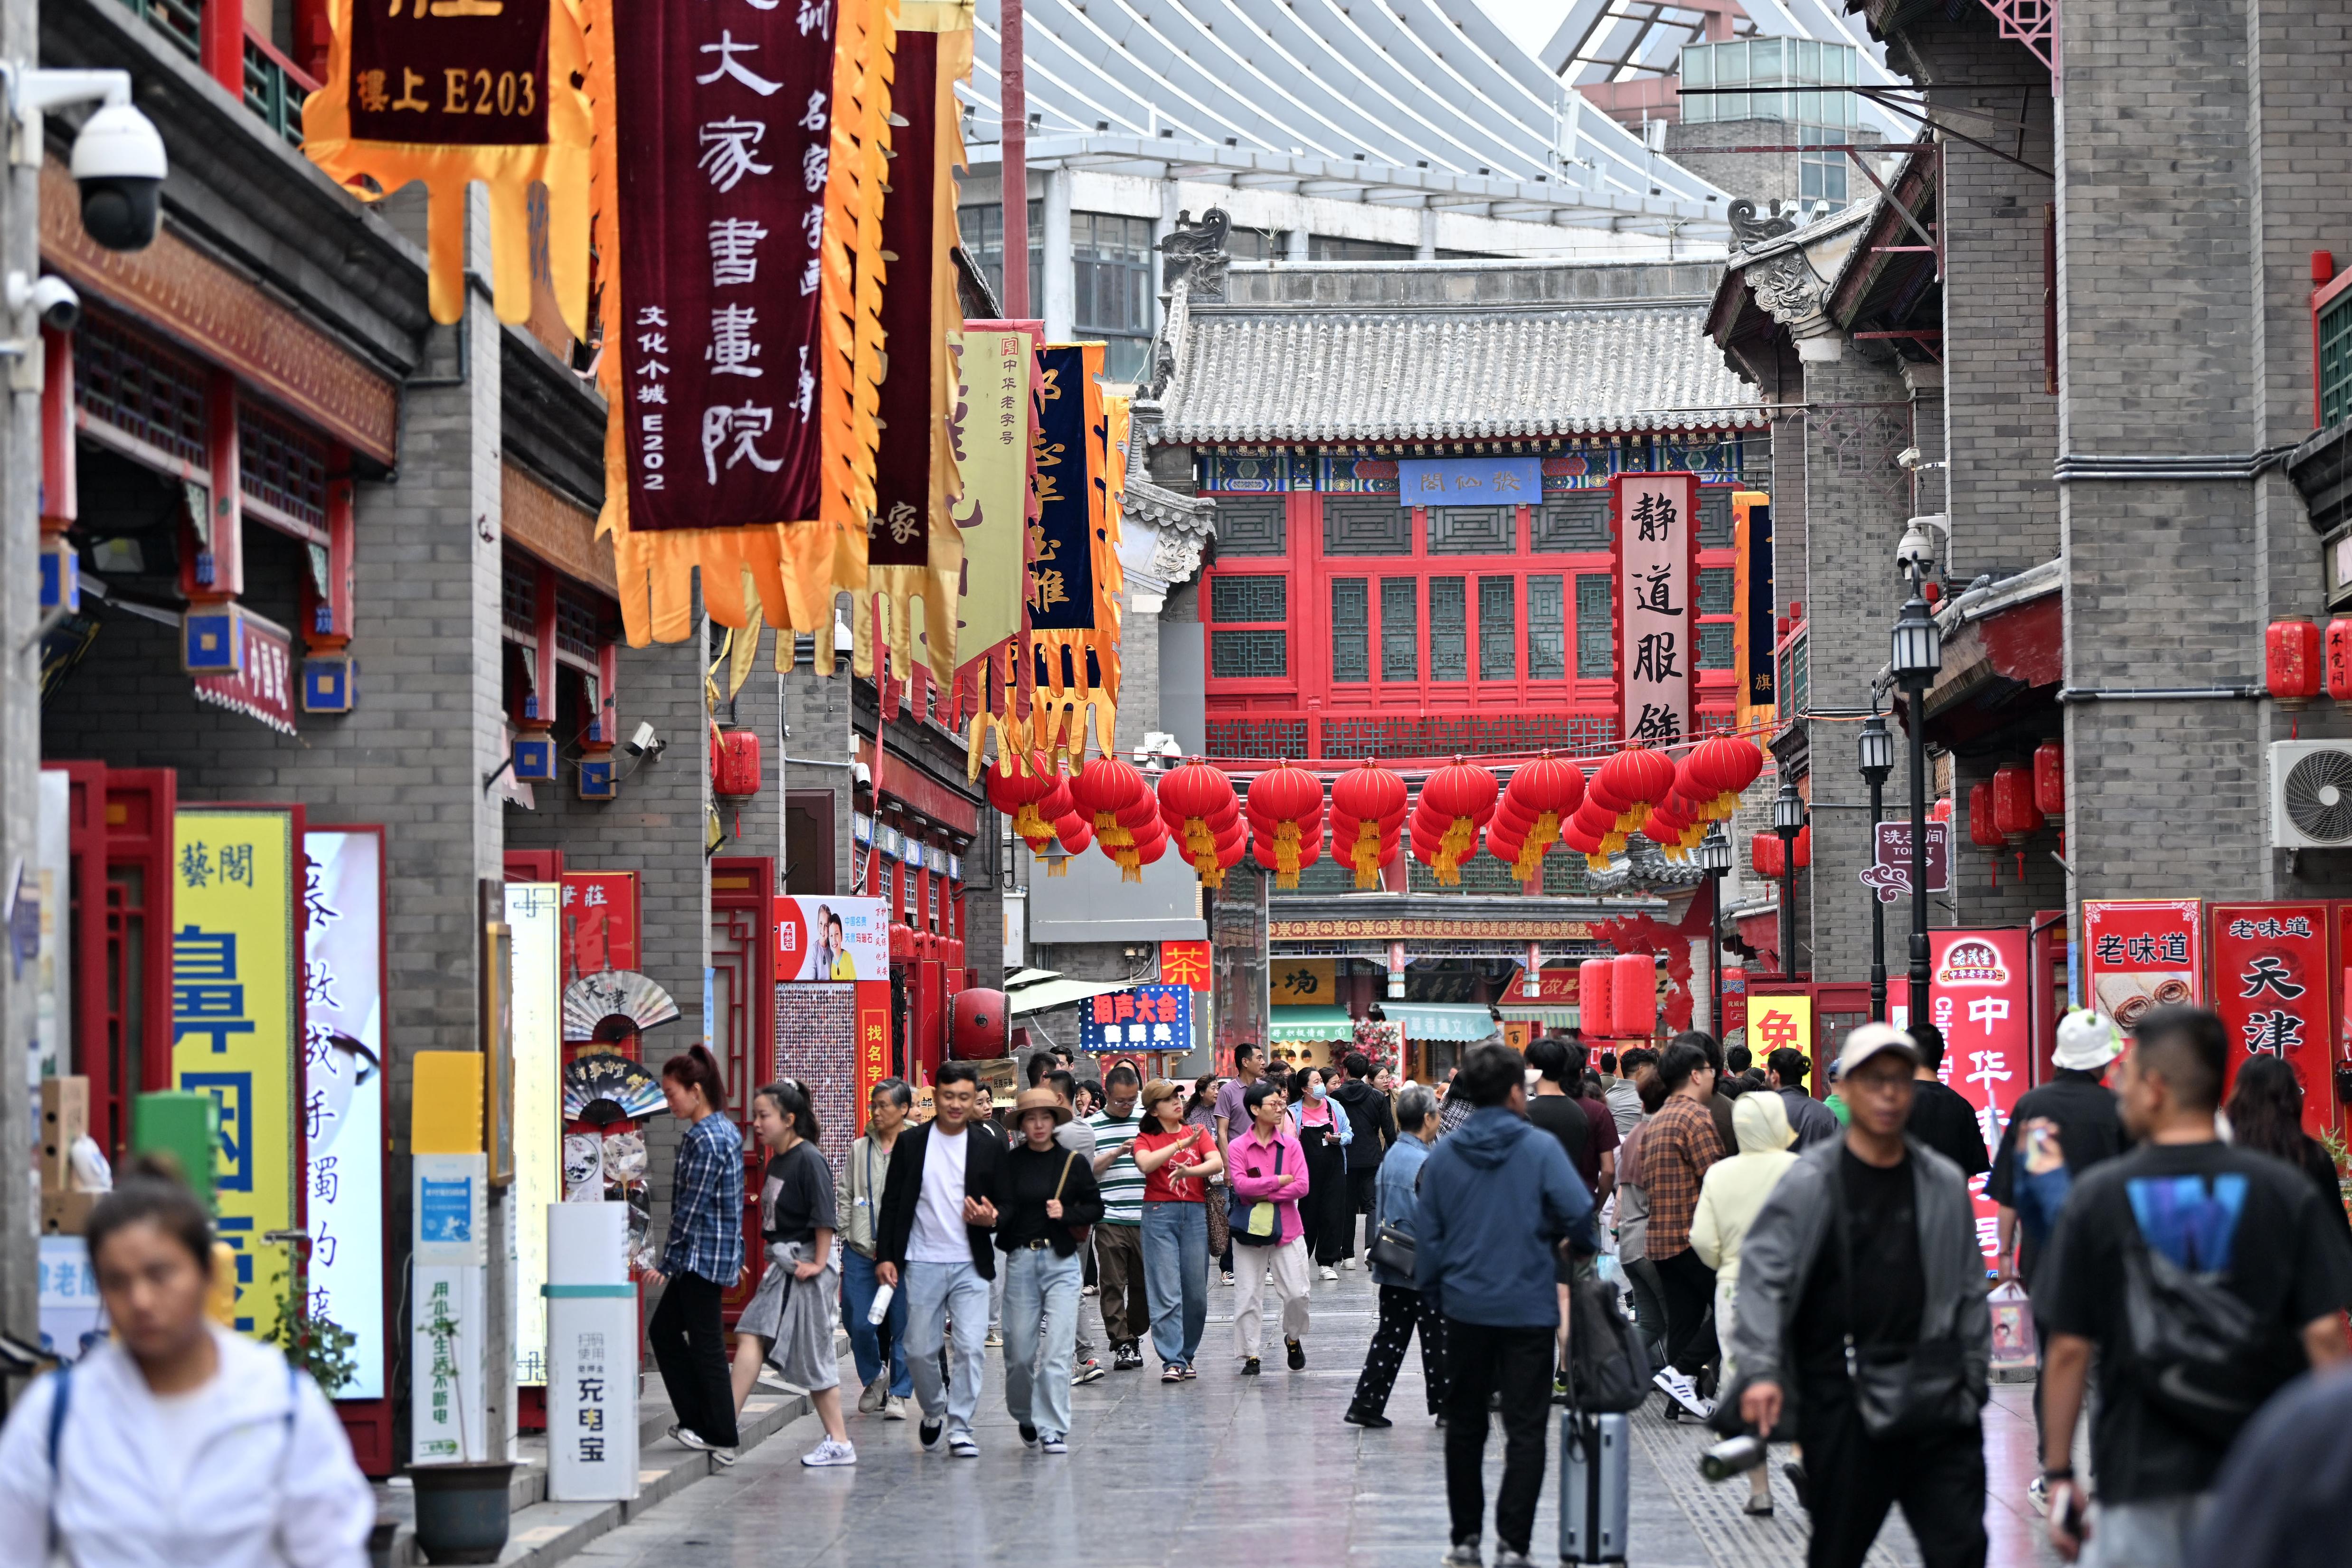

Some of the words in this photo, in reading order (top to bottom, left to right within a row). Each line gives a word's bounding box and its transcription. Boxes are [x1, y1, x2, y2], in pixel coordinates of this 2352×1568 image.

[442, 68, 536, 117] E203
[696, 0, 784, 485] 大家書畫院
[999, 359, 1017, 445] 中华老字号
[643, 414, 664, 491] E202
[1755, 673, 1772, 691] 旗
[1893, 847, 1934, 855] TOIT
[844, 916, 867, 927] 中国名贵
[2228, 916, 2313, 939] 老味道
[784, 928, 793, 948] 平安石
[844, 933, 873, 944] 天然玛瑙石
[2096, 932, 2189, 965] 老味道
[1162, 947, 1209, 984] 茶
[1950, 970, 1994, 979] 中华老字号
[1093, 992, 1177, 1024] 相声大会
[2239, 956, 2306, 1061] 天津
[1397, 1016, 1475, 1035] 草香囊文化
[1756, 1010, 1804, 1067] 免
[867, 1025, 882, 1121] 找名字
[993, 1078, 1013, 1088] 民族乐器
[577, 1378, 605, 1463] 充电宝
